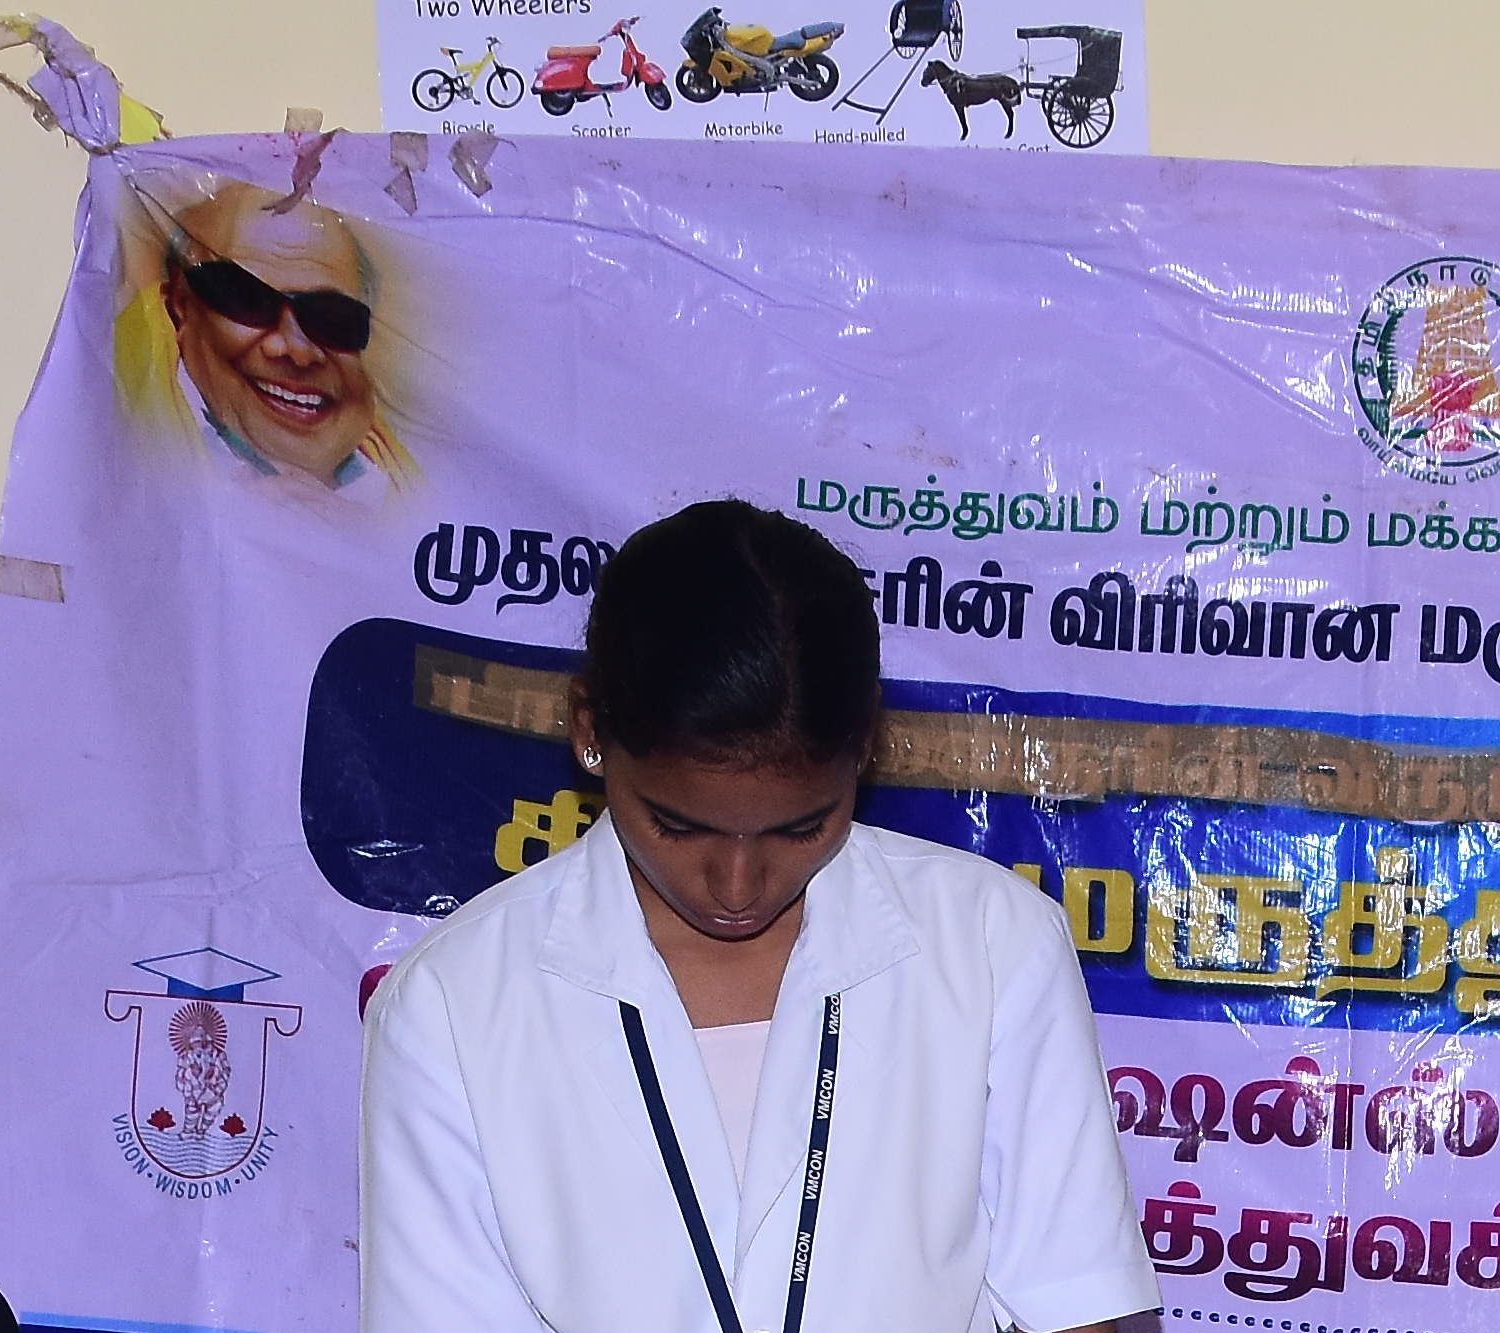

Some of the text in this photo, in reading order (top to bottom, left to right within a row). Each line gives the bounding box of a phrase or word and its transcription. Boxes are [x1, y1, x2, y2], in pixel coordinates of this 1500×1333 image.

[415, 0, 592, 18] Two Wheelers
[571, 124, 632, 138] Scooter
[704, 121, 784, 138] Motorbike
[814, 127, 906, 144] Hand-pulled
[797, 476, 1120, 538] மருத்துவம்
[1140, 491, 1350, 558] மற்றும்
[1050, 570, 1401, 662] விரிவான
[828, 995, 840, 1035] VMCO
[817, 1069, 834, 1120] VMCON
[1107, 1055, 1500, 1163] ஷன்ஸ்
[112, 1112, 279, 1200] VISION WISDOM UNITY
[805, 1149, 824, 1201] VMCON
[793, 1232, 811, 1283] VMCON
